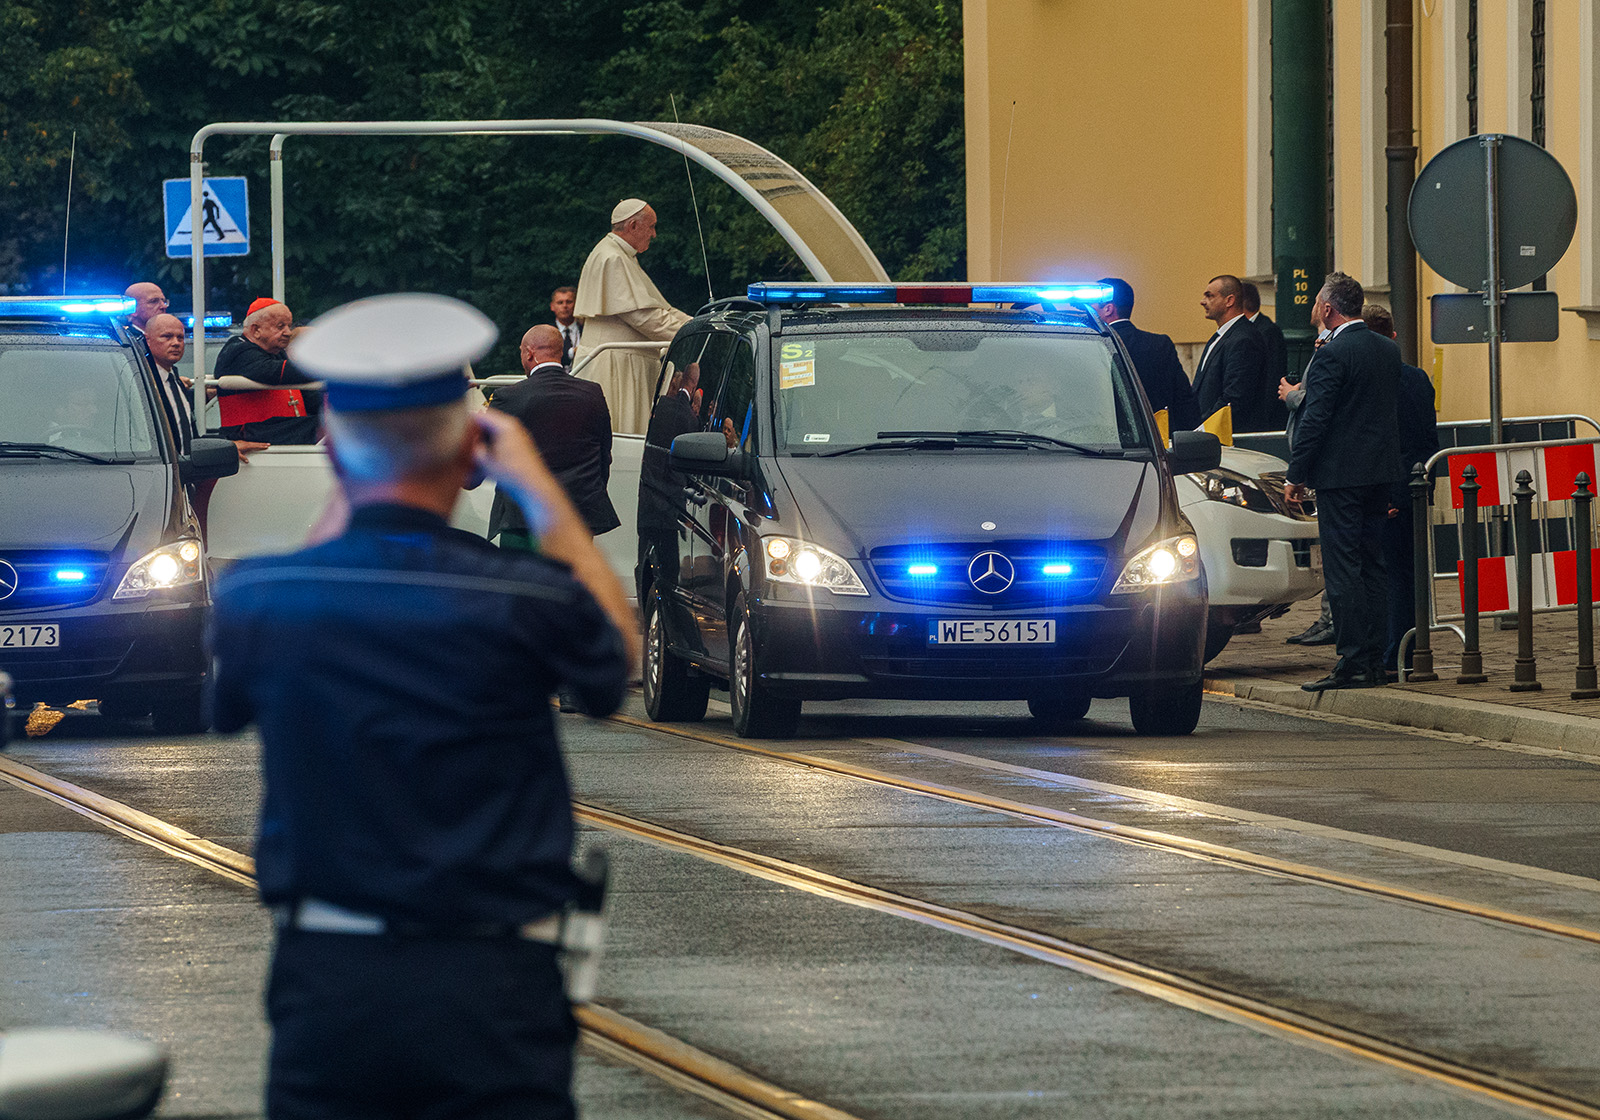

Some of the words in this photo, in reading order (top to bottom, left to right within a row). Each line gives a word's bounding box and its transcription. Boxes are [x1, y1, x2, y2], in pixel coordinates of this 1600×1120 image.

[1293, 268, 1308, 279] PL
[1295, 282, 1308, 292] 10
[1294, 295, 1308, 304] 02
[943, 622, 974, 642] WE
[984, 621, 1050, 642] 56151
